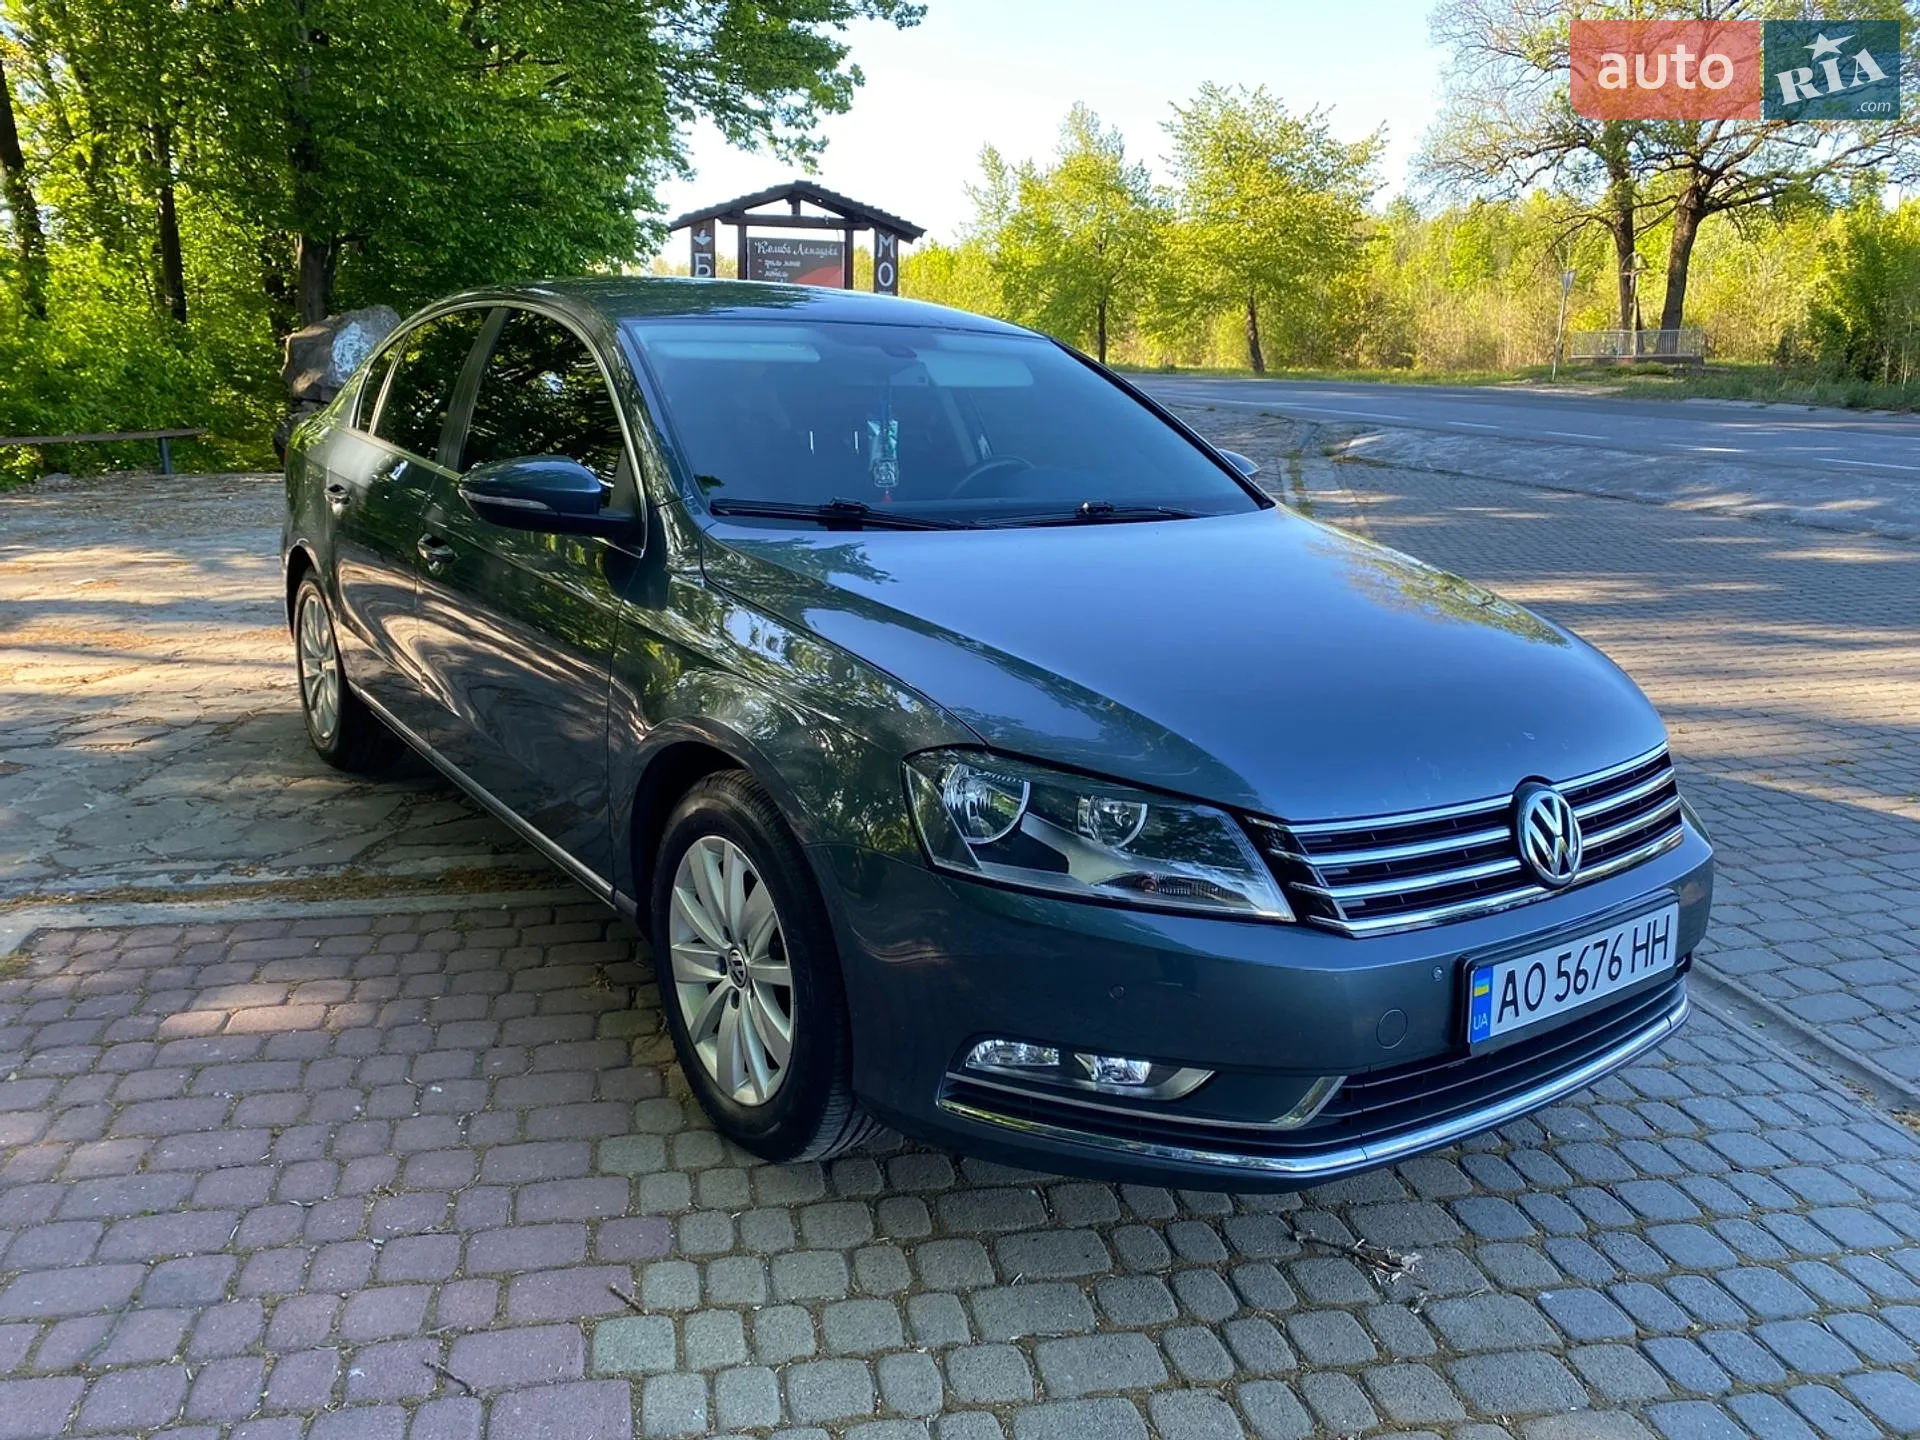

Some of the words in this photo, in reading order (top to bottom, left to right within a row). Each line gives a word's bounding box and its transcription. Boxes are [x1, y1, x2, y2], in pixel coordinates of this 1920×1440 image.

[878, 233, 895, 295] МО
[1497, 962, 1546, 1023] AO
[1554, 932, 1624, 1002] 5676
[1631, 914, 1670, 973] HH
[1473, 1013, 1488, 1030] UA
